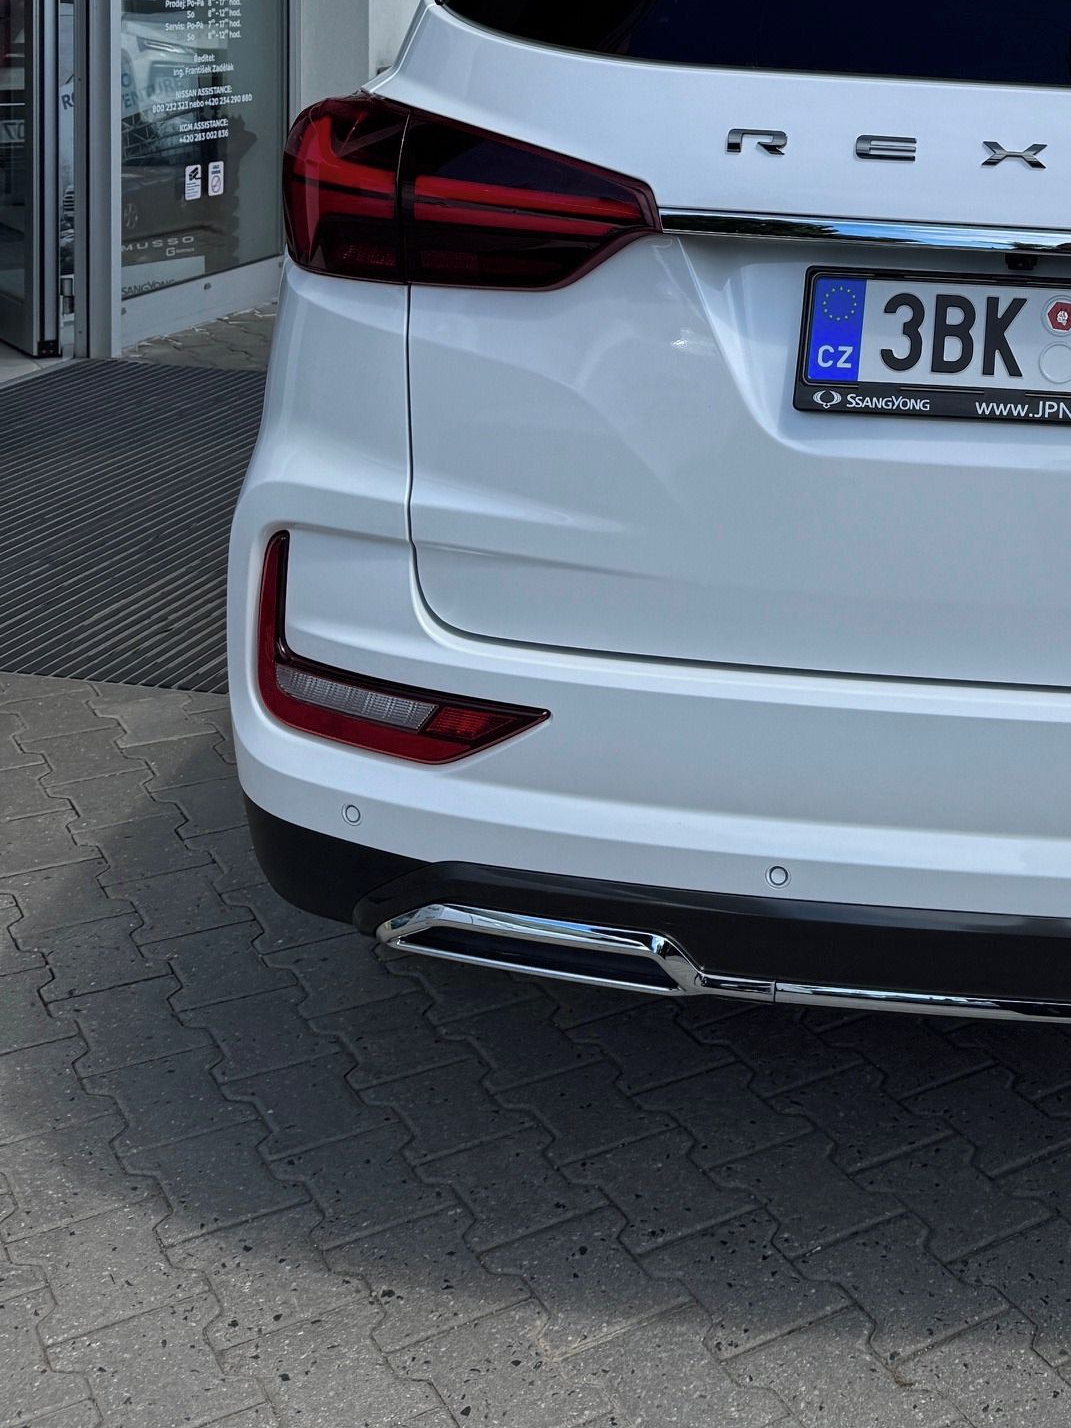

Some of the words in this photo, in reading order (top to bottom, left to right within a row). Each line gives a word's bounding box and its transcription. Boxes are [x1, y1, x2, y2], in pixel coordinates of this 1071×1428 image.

[165, 0, 186, 9] Prodej:
[186, 10, 195, 19] So
[229, 7, 242, 17] hod.
[186, 20, 204, 30] Po-Pá
[229, 18, 242, 28] hod.
[186, 33, 195, 41] So
[229, 29, 242, 39] hod.
[185, 65, 212, 76] František
[176, 89, 197, 99] NISSAN
[197, 85, 233, 96] ASSISTANCE:
[189, 99, 205, 109] nebo
[204, 97, 219, 107] +420
[219, 96, 230, 105] 234
[230, 95, 242, 104] 290
[180, 123, 194, 133] KGM
[193, 118, 229, 130] ASSISTANCE:
[179, 133, 194, 143] +420
[206, 130, 218, 140] 002
[121, 235, 194, 252] MUSSO
[880, 292, 1028, 378] 3BK
[816, 344, 854, 368] CZ
